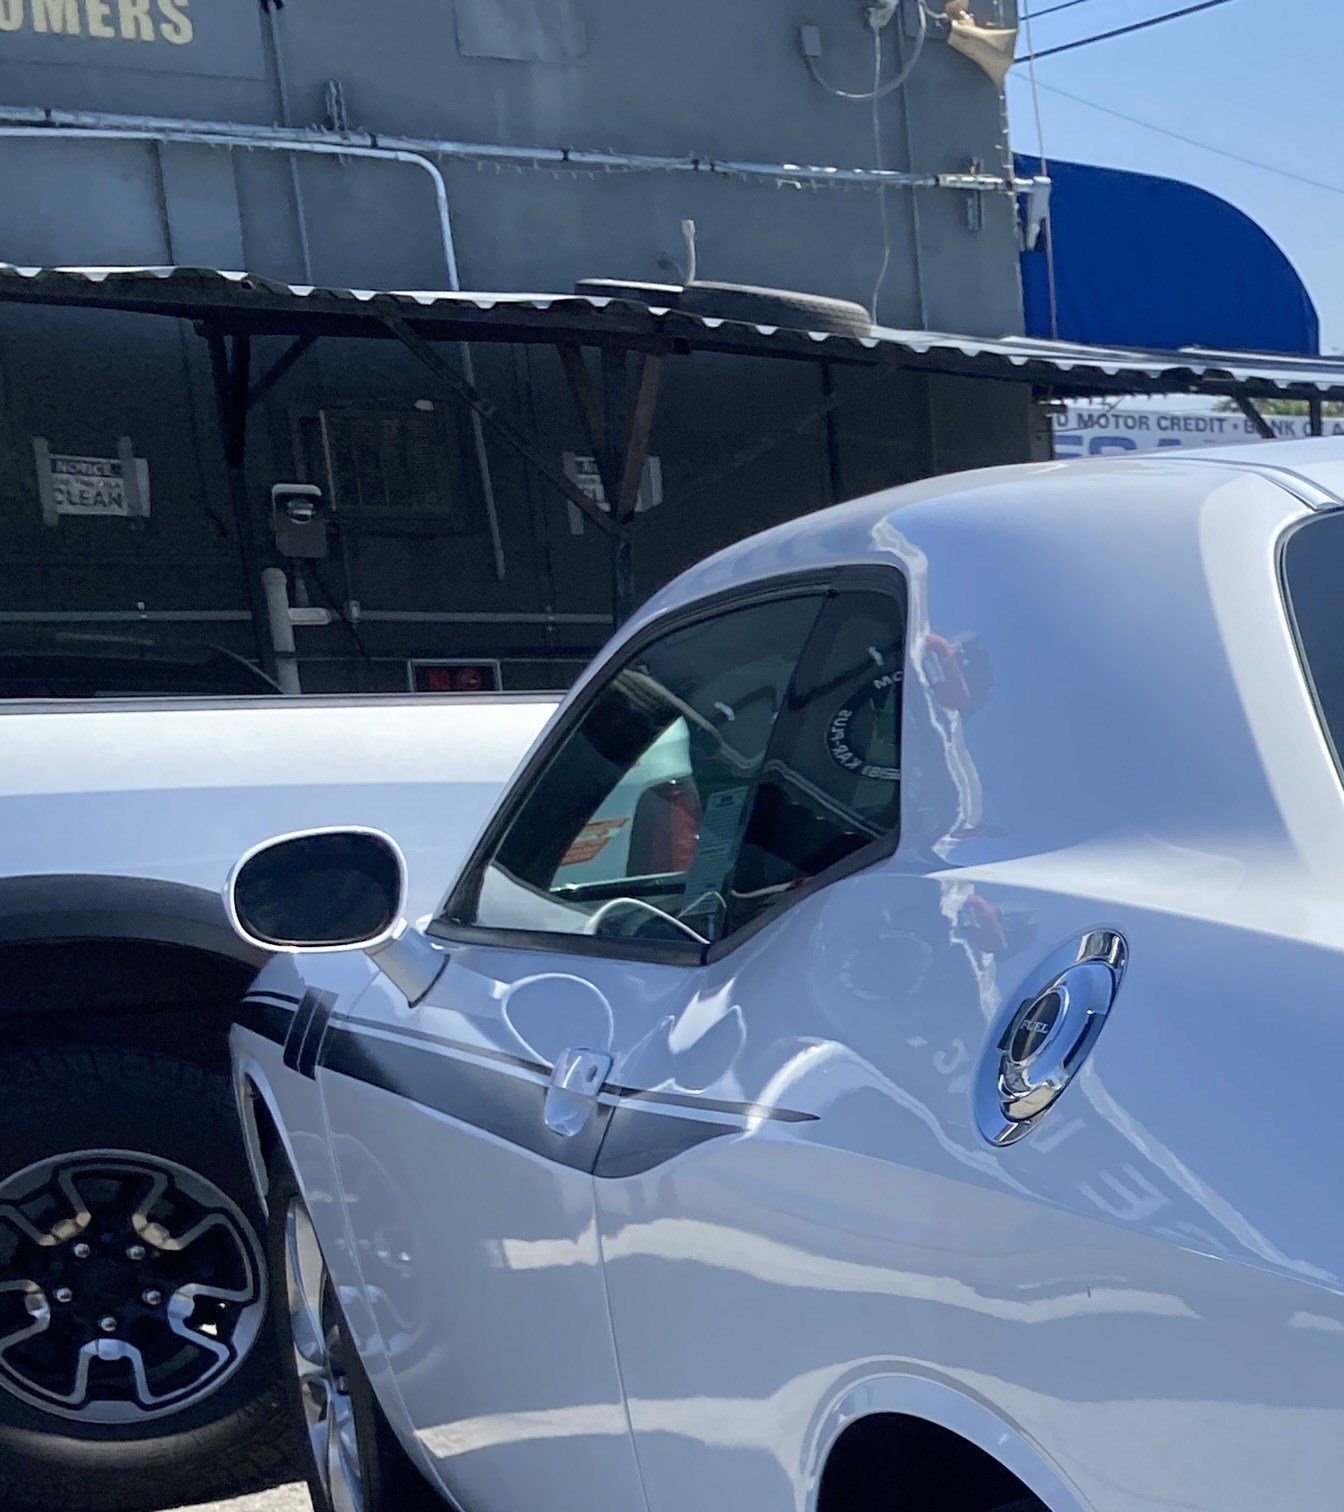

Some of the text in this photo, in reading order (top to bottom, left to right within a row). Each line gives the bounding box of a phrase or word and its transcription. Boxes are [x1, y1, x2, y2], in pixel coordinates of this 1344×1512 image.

[1077, 412, 1150, 430] MOTOR
[1156, 415, 1227, 433] CREDIT
[1243, 418, 1296, 437] BNK
[1020, 1019, 1049, 1034] FUEL
